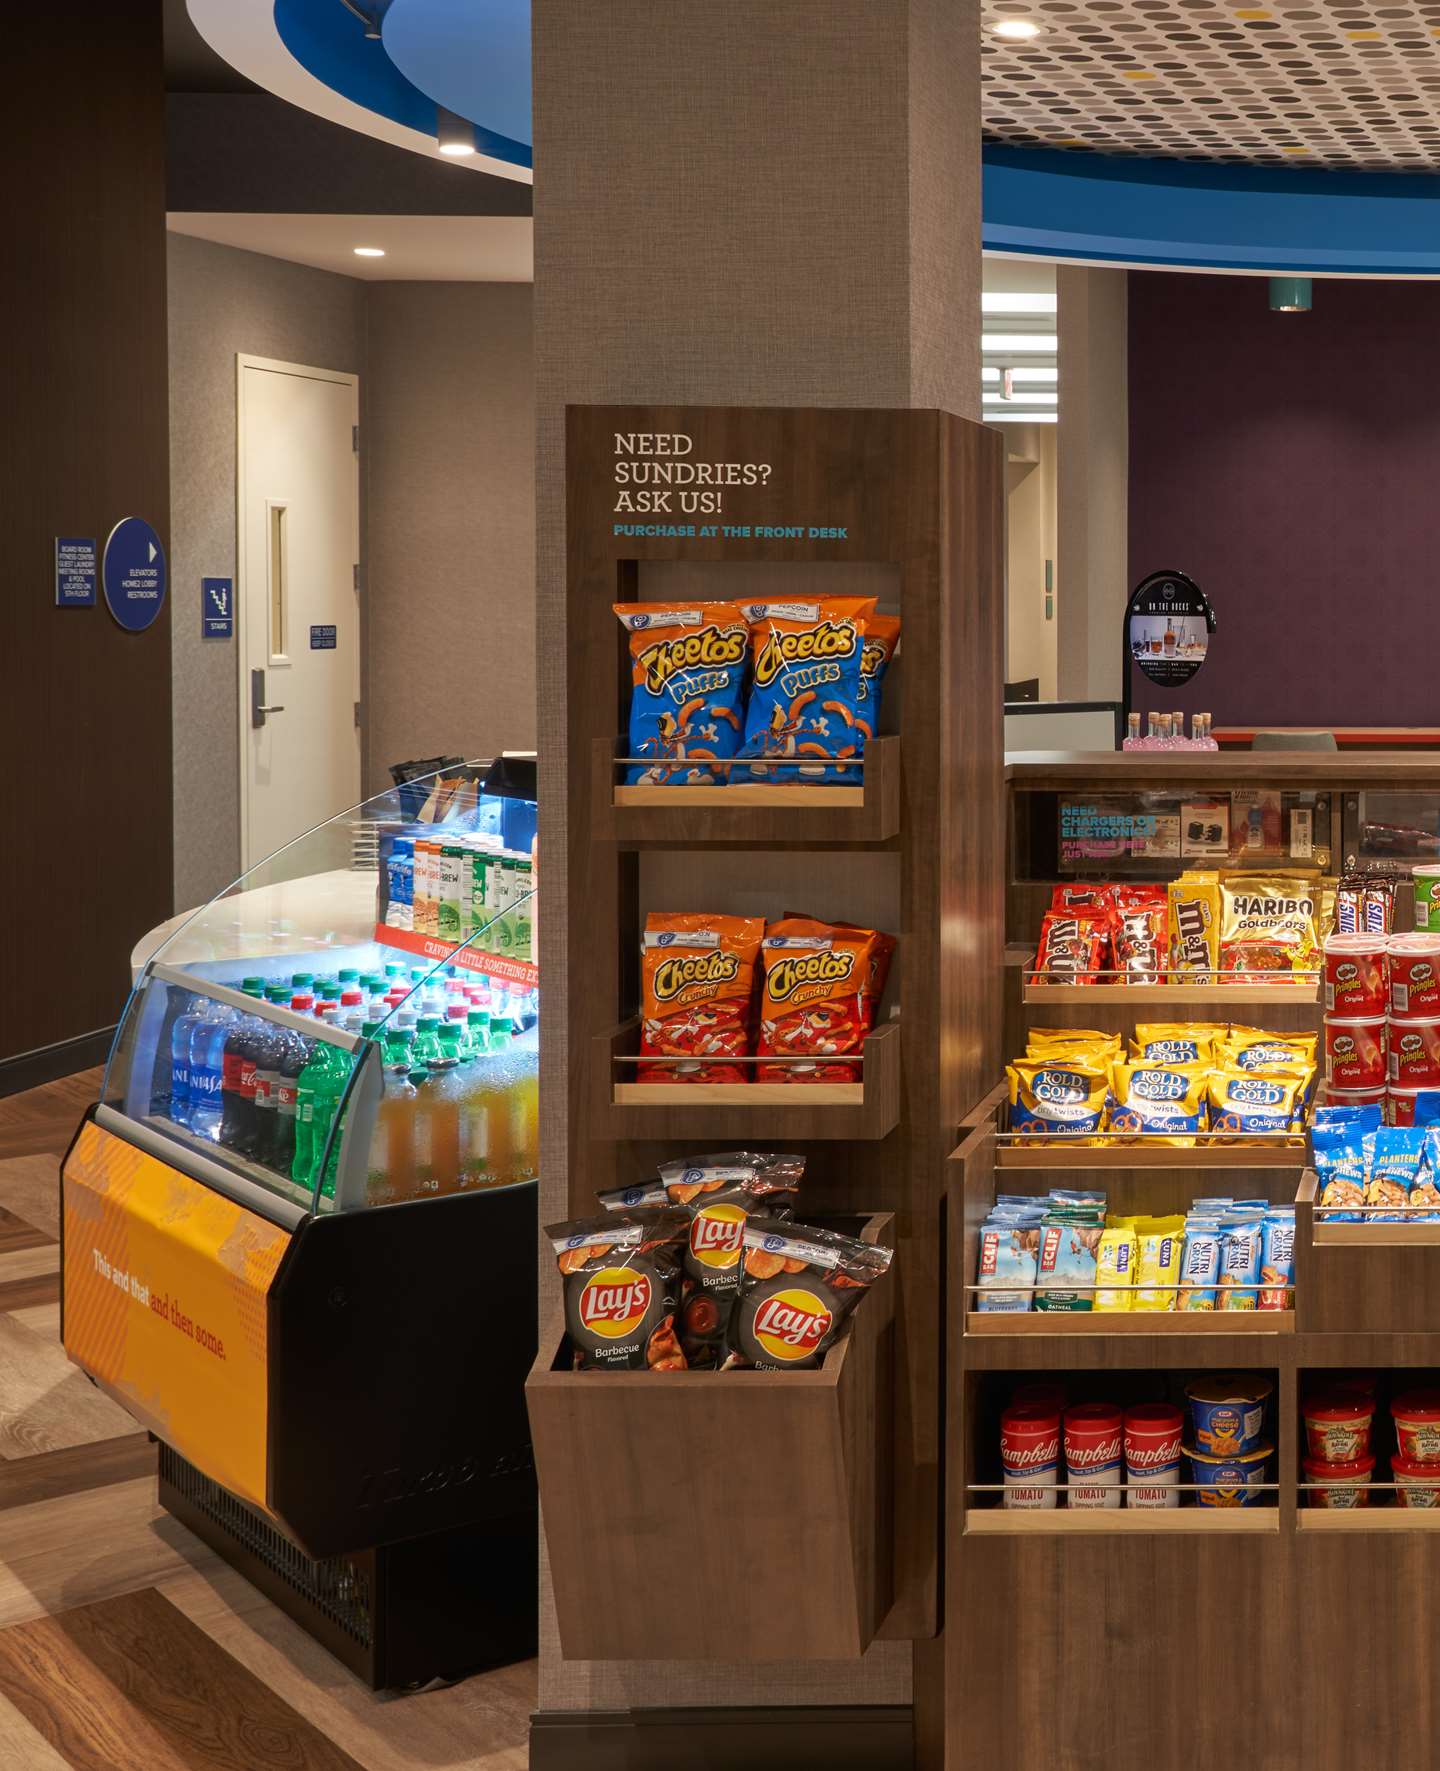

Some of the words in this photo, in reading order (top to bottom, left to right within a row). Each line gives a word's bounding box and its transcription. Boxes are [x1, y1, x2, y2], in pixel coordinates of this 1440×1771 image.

[613, 433, 693, 456] NEED
[613, 461, 772, 486] SUNDRIES?
[613, 490, 673, 513] ASK
[679, 491, 723, 514] US!
[613, 523, 696, 538] PURCHASE
[699, 524, 717, 538] AT
[723, 525, 751, 538] THE
[754, 526, 805, 539] FRONT
[808, 526, 849, 540] DESK
[130, 569, 158, 577] ELEVATORS
[141, 580, 158, 588] LOBBY
[128, 591, 158, 599] RESTROOMS
[211, 622, 227, 631] STAIRS
[640, 626, 743, 690] Cheetos
[755, 623, 854, 685] Cheetos
[1061, 806, 1097, 816] NEED
[1061, 816, 1133, 826] CHARGERS
[1233, 897, 1313, 917] HARIBO
[460, 951, 483, 967] LITTLE
[484, 958, 527, 980] SOMETHING
[655, 951, 738, 1000] Cheetos
[768, 951, 853, 1000] Cheetos
[677, 984, 719, 1004] Crunchy
[791, 984, 833, 1005] Crunchy
[1336, 979, 1361, 996] Pringles
[1409, 979, 1436, 998] Pringles
[1148, 1040, 1190, 1052] ROLD
[1246, 1050, 1287, 1062] ROLD
[1333, 1051, 1358, 1068] Pringles
[1041, 1071, 1084, 1086] ROLD
[1140, 1071, 1183, 1086] ROLD
[1237, 1079, 1275, 1091] ROLD
[1036, 1083, 1085, 1100] GOLD
[1138, 1083, 1183, 1098] GOLD
[1231, 1088, 1280, 1101] GOLD
[1148, 1104, 1179, 1114] twists
[1249, 1118, 1286, 1130] Original
[1379, 1154, 1419, 1164] PLANTERS
[694, 1216, 745, 1254] Lay
[983, 1233, 998, 1265] CLIF
[1043, 1230, 1059, 1261] CLIF
[1160, 1238, 1171, 1266] LUNA
[1229, 1236, 1240, 1270] GRAIN
[1239, 1235, 1251, 1269] NUTRI
[1273, 1229, 1284, 1262] GRAIN
[1283, 1230, 1294, 1262] NUTRI
[1189, 1242, 1201, 1275] GRAIN
[1200, 1242, 1213, 1274] NUTRI
[93, 1248, 111, 1280] This
[112, 1265, 129, 1293] and
[131, 1277, 150, 1308] that
[150, 1294, 169, 1321] and
[171, 1300, 194, 1339] then
[196, 1324, 226, 1361] some.
[586, 1272, 648, 1322] Lay's
[758, 1300, 828, 1345] Lay's
[595, 1343, 640, 1359] Barbecue
[1011, 1489, 1043, 1500] TOMATO
[1074, 1488, 1106, 1499] TOMATO
[1135, 1488, 1167, 1499] TOMATO
